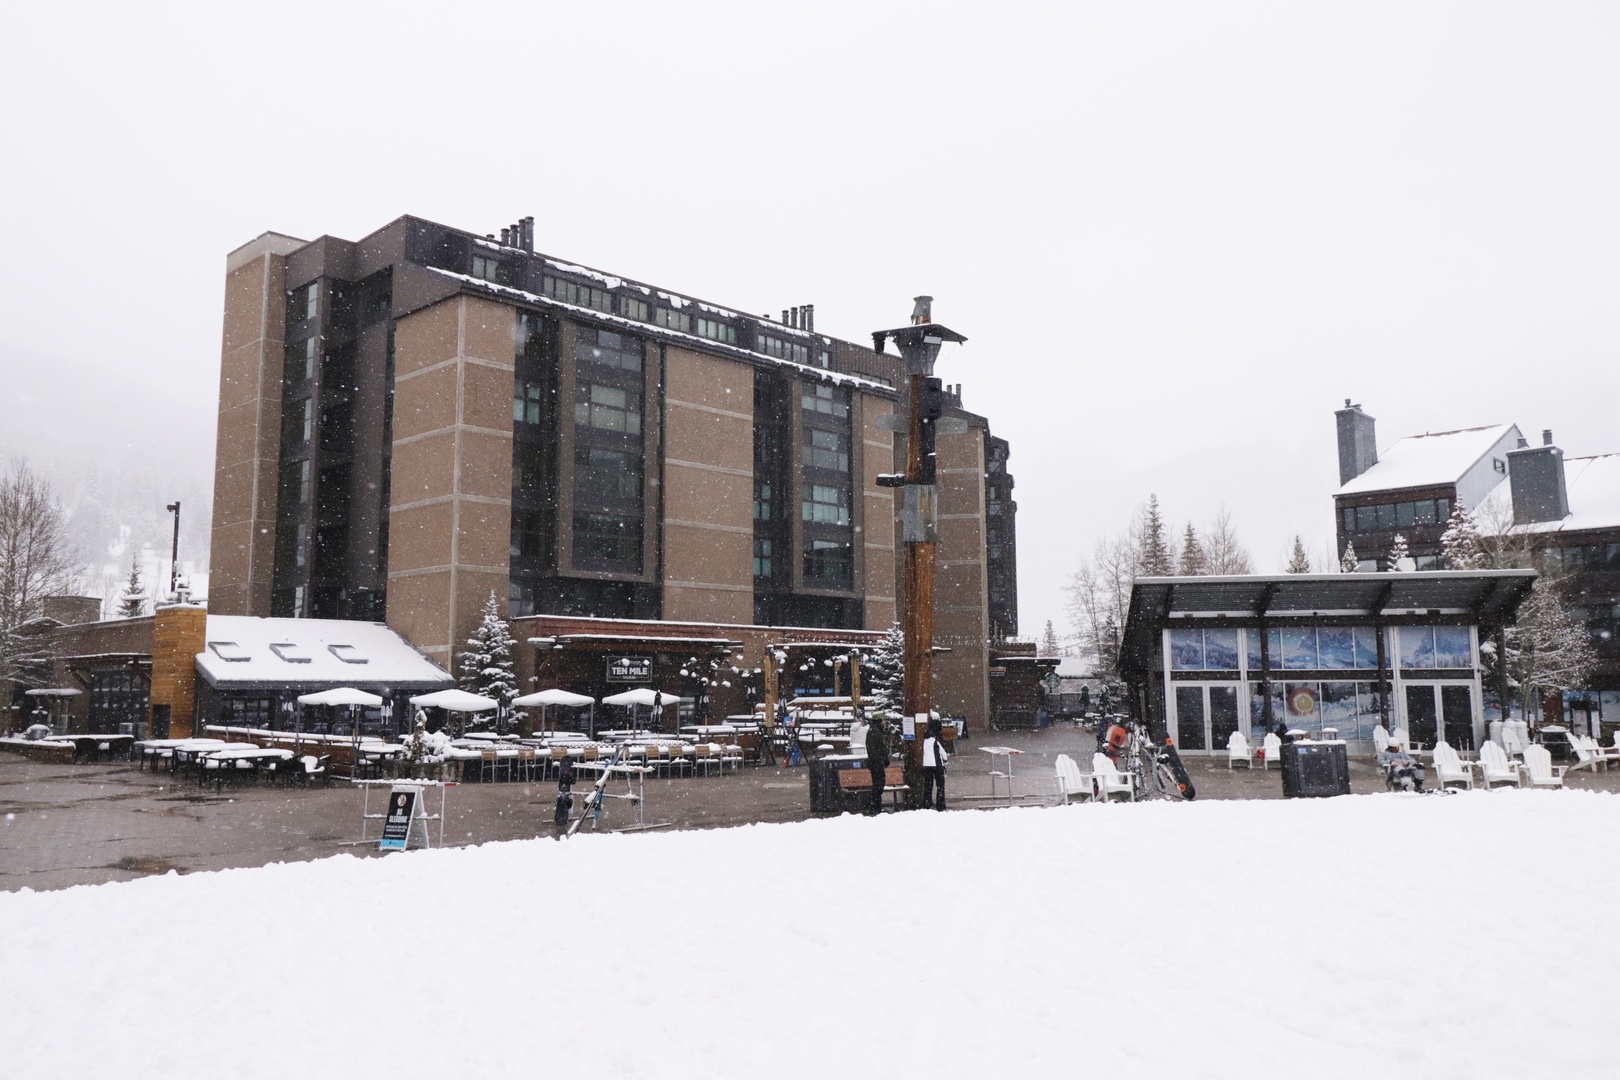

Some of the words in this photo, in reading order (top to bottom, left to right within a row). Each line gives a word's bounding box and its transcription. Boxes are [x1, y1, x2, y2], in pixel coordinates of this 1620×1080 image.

[611, 667, 627, 675] TEN
[629, 667, 648, 675] MILE
[389, 815, 408, 823] SLEDDING
